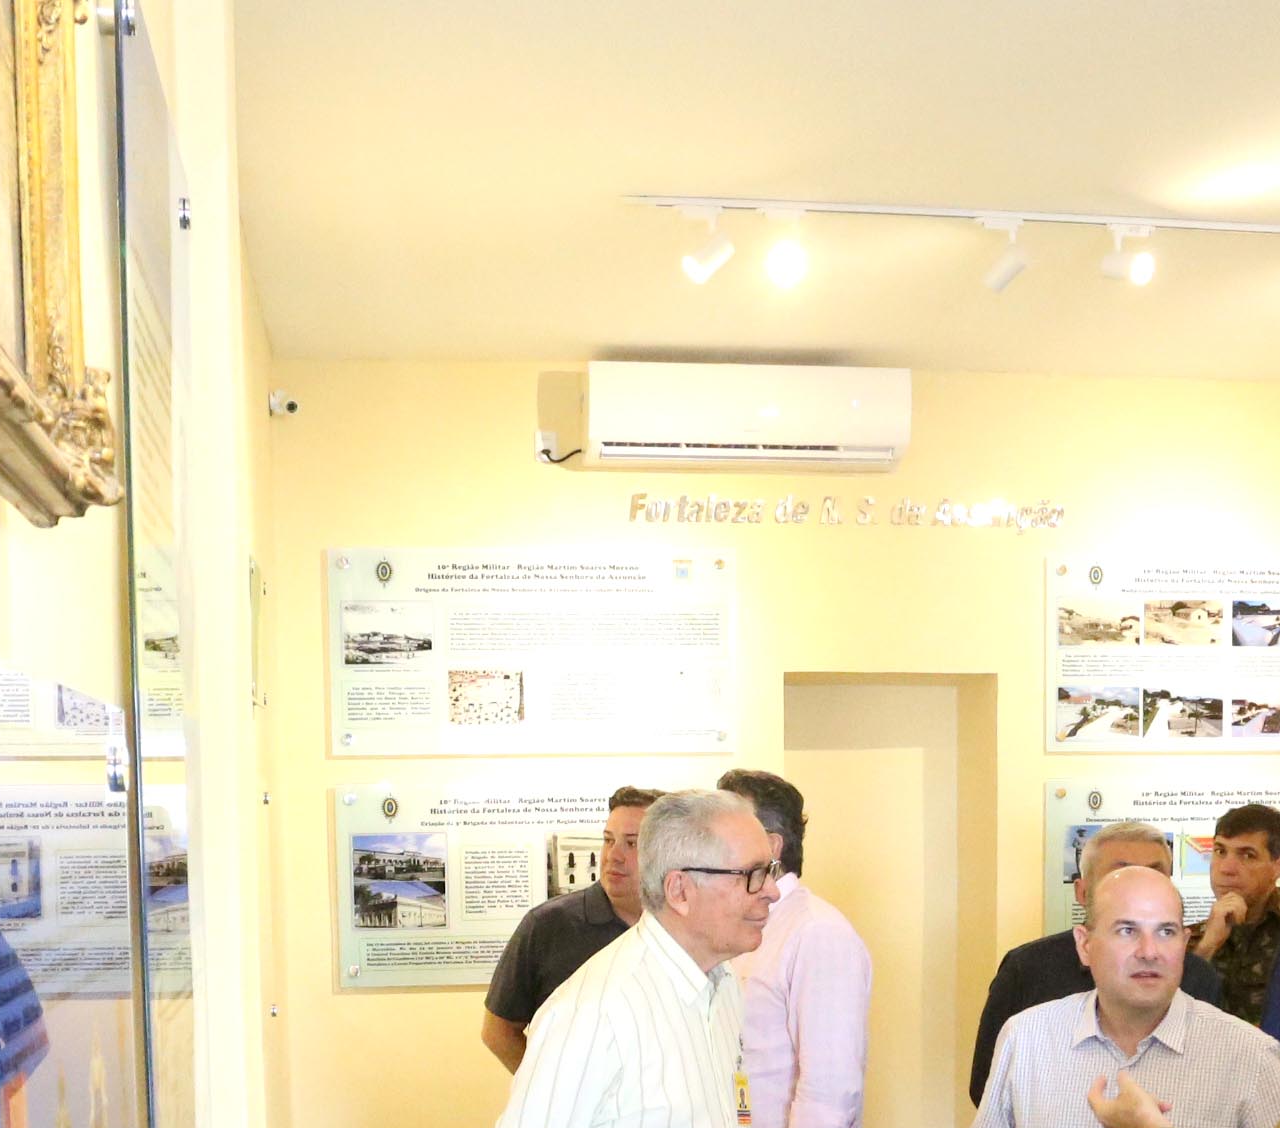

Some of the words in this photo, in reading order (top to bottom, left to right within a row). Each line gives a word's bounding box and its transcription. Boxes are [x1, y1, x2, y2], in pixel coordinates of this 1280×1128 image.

[629, 493, 766, 524] Fortaleza
[775, 494, 810, 524] de
[452, 563, 479, 571] Região
[1154, 790, 1179, 798] Região
[518, 797, 545, 805] Região
